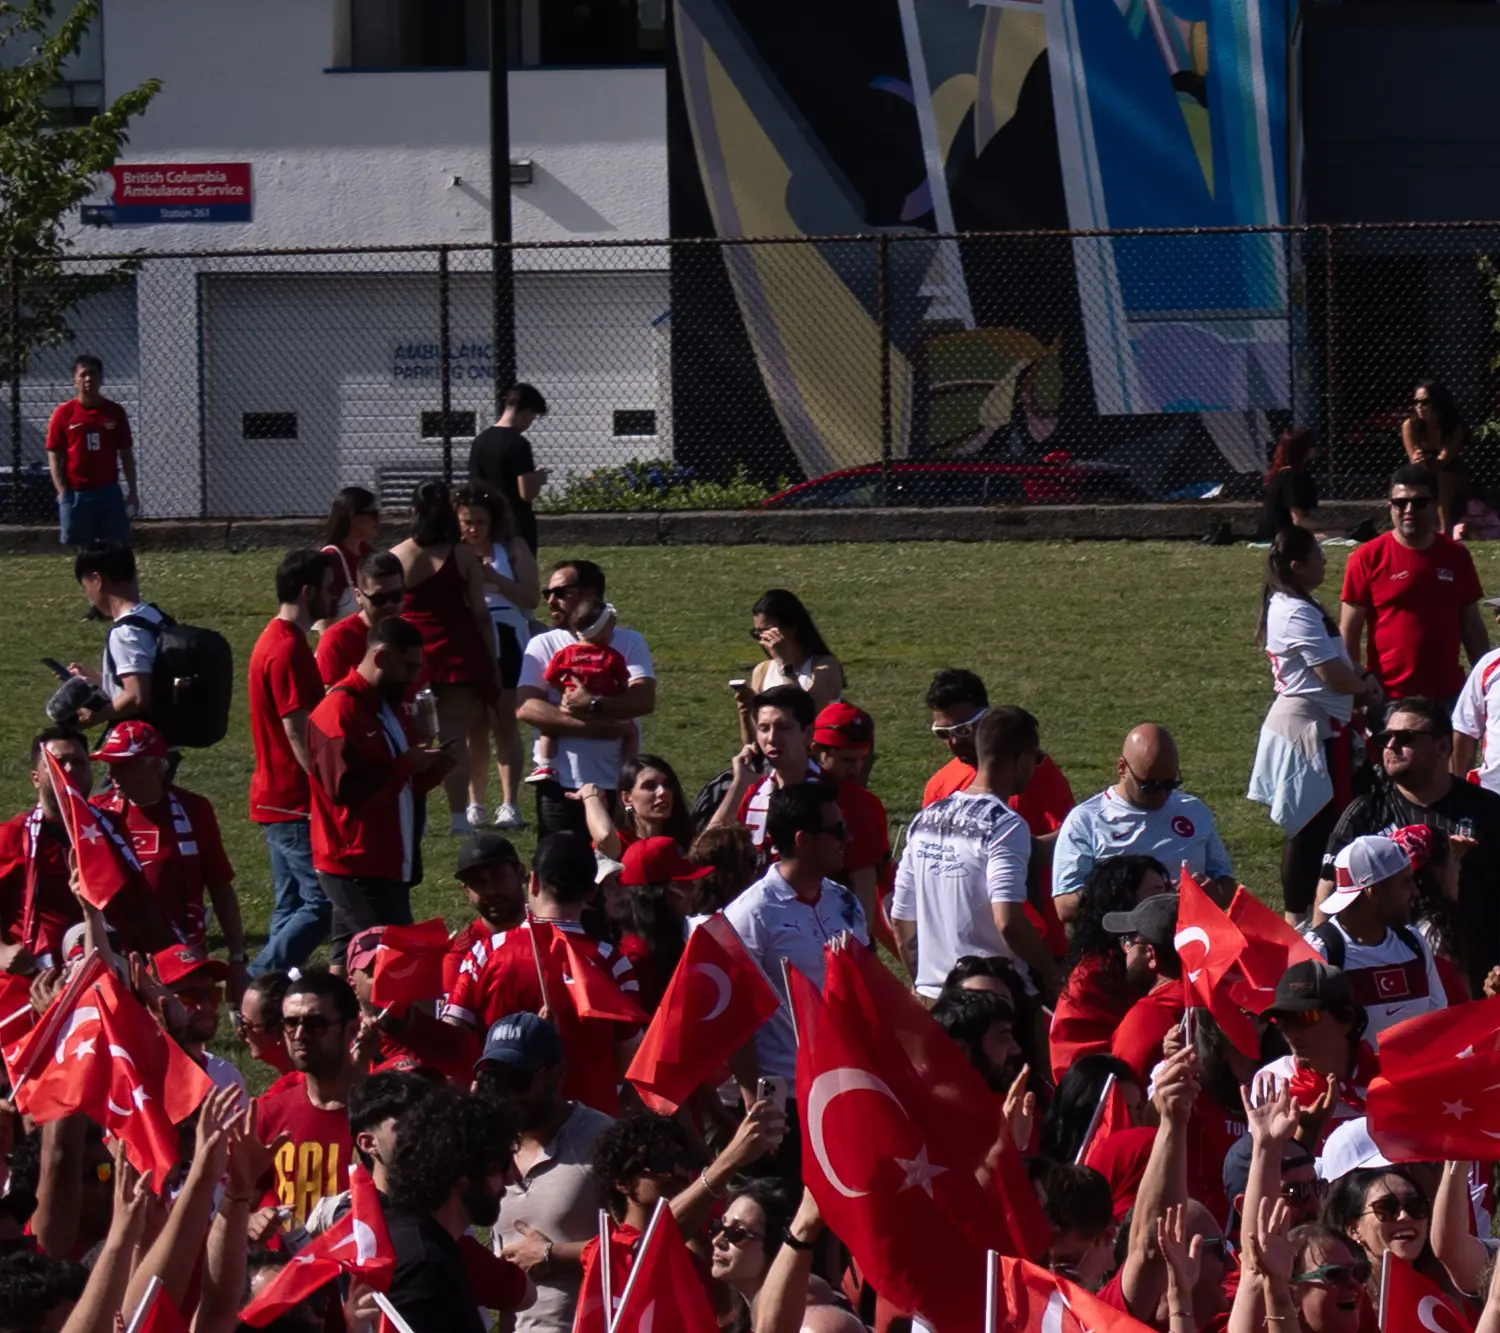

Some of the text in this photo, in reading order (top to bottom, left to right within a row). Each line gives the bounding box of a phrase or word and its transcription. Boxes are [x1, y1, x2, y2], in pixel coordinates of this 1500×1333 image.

[124, 171, 227, 187] British Columbia
[124, 184, 246, 199] Ambulance Service
[160, 207, 192, 219] Station
